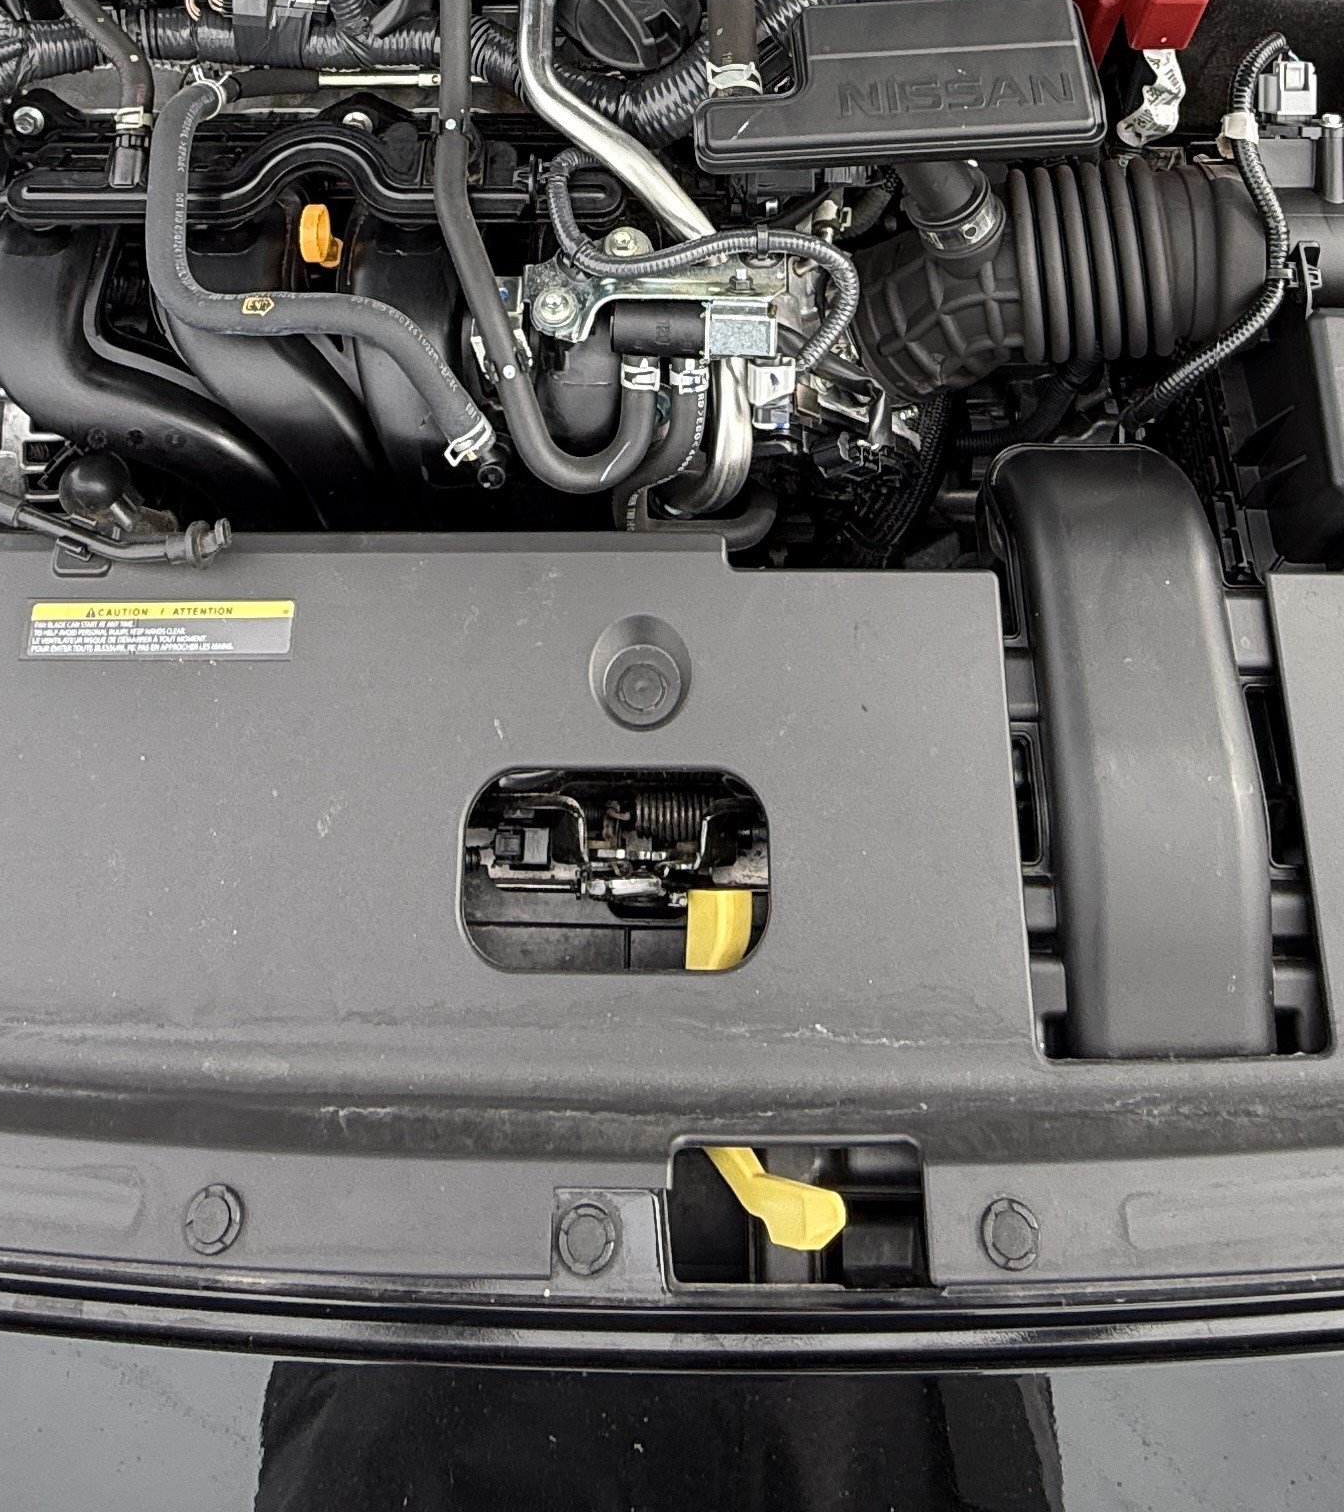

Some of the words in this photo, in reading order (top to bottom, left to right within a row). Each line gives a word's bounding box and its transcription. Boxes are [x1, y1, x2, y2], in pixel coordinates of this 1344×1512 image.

[837, 72, 1075, 119] NISSAN
[98, 608, 149, 617] CAUTION
[173, 607, 234, 615] ATTENTION
